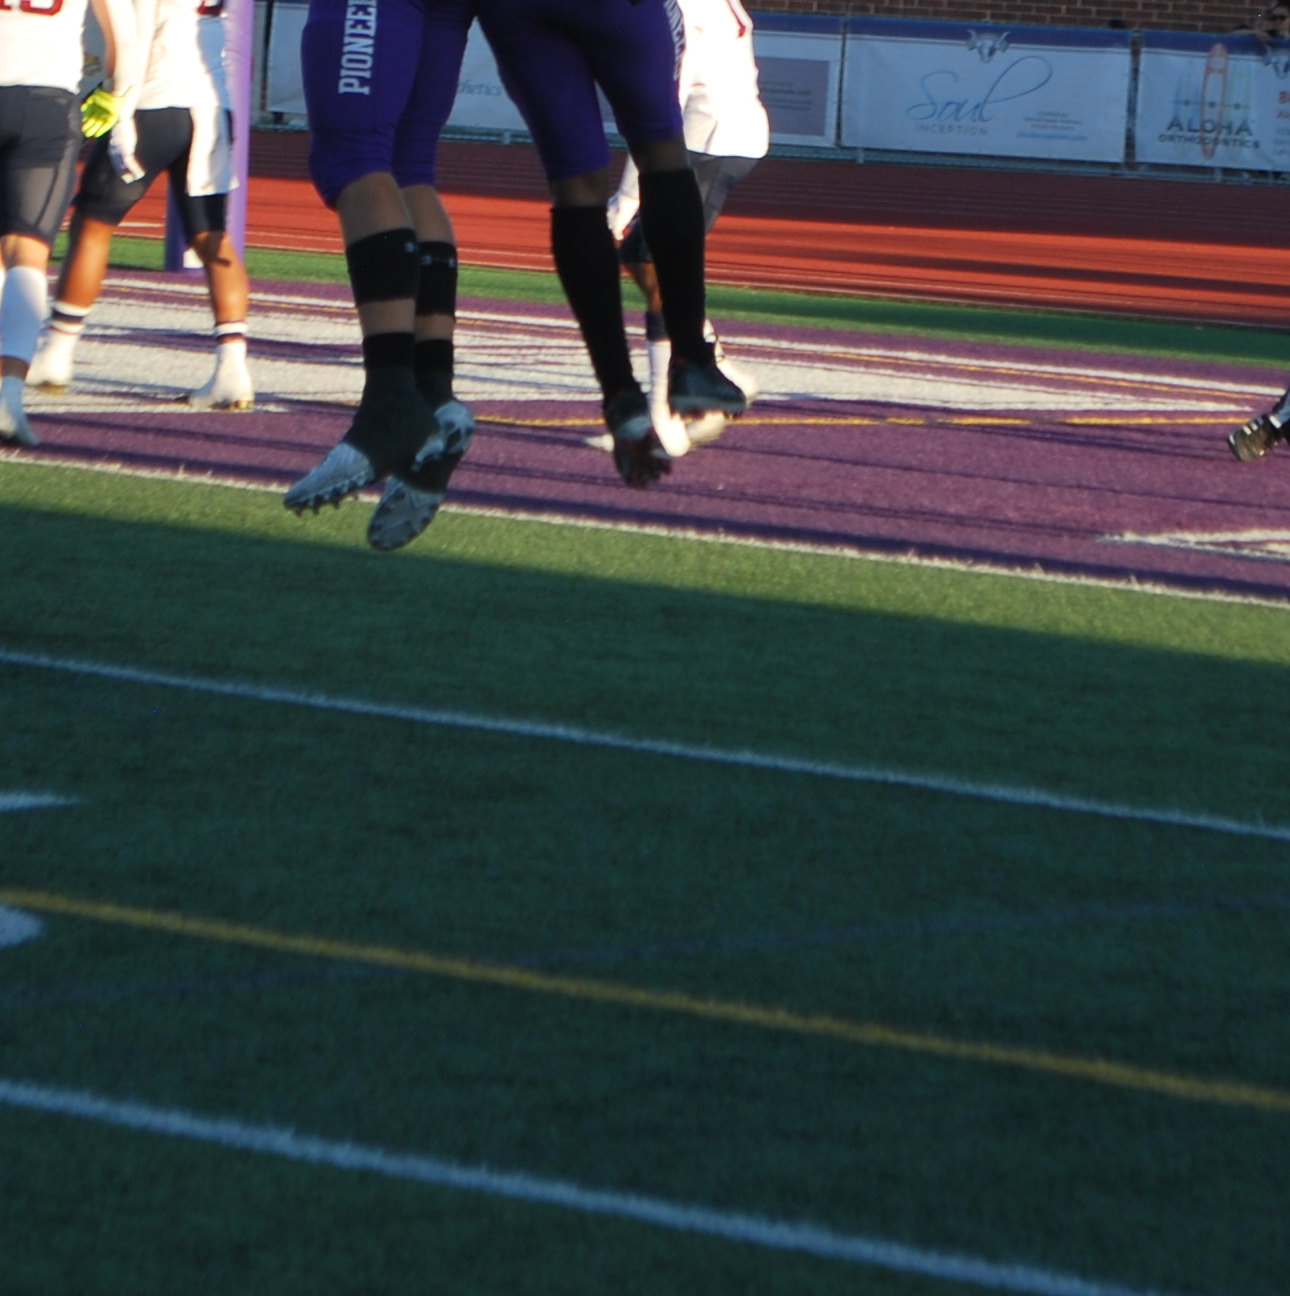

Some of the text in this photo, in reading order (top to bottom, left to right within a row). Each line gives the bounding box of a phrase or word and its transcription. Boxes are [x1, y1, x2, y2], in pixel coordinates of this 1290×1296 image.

[906, 56, 1053, 122] Soul
[915, 124, 989, 136] INCEPTION
[1166, 114, 1252, 136] ALOHA
